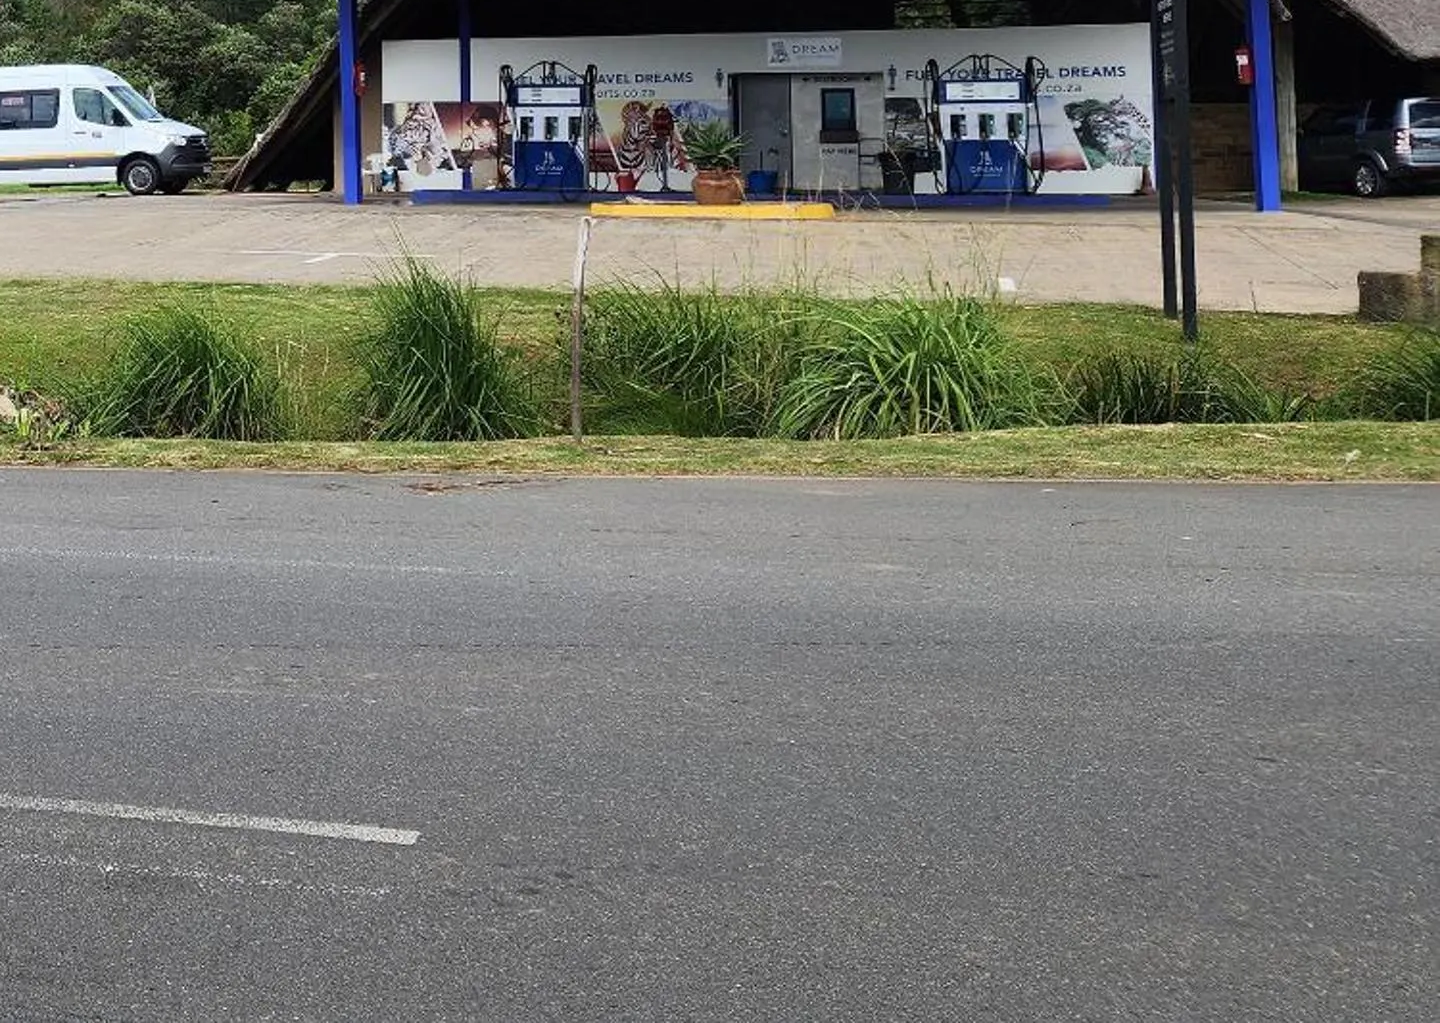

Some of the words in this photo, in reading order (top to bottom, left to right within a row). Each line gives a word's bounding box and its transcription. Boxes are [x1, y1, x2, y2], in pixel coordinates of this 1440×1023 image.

[792, 44, 839, 54] DREAM
[597, 74, 631, 84] AVEL
[635, 72, 693, 83] DREAMS
[995, 68, 1054, 79] TRAEL
[1060, 66, 1126, 78] DREAMS
